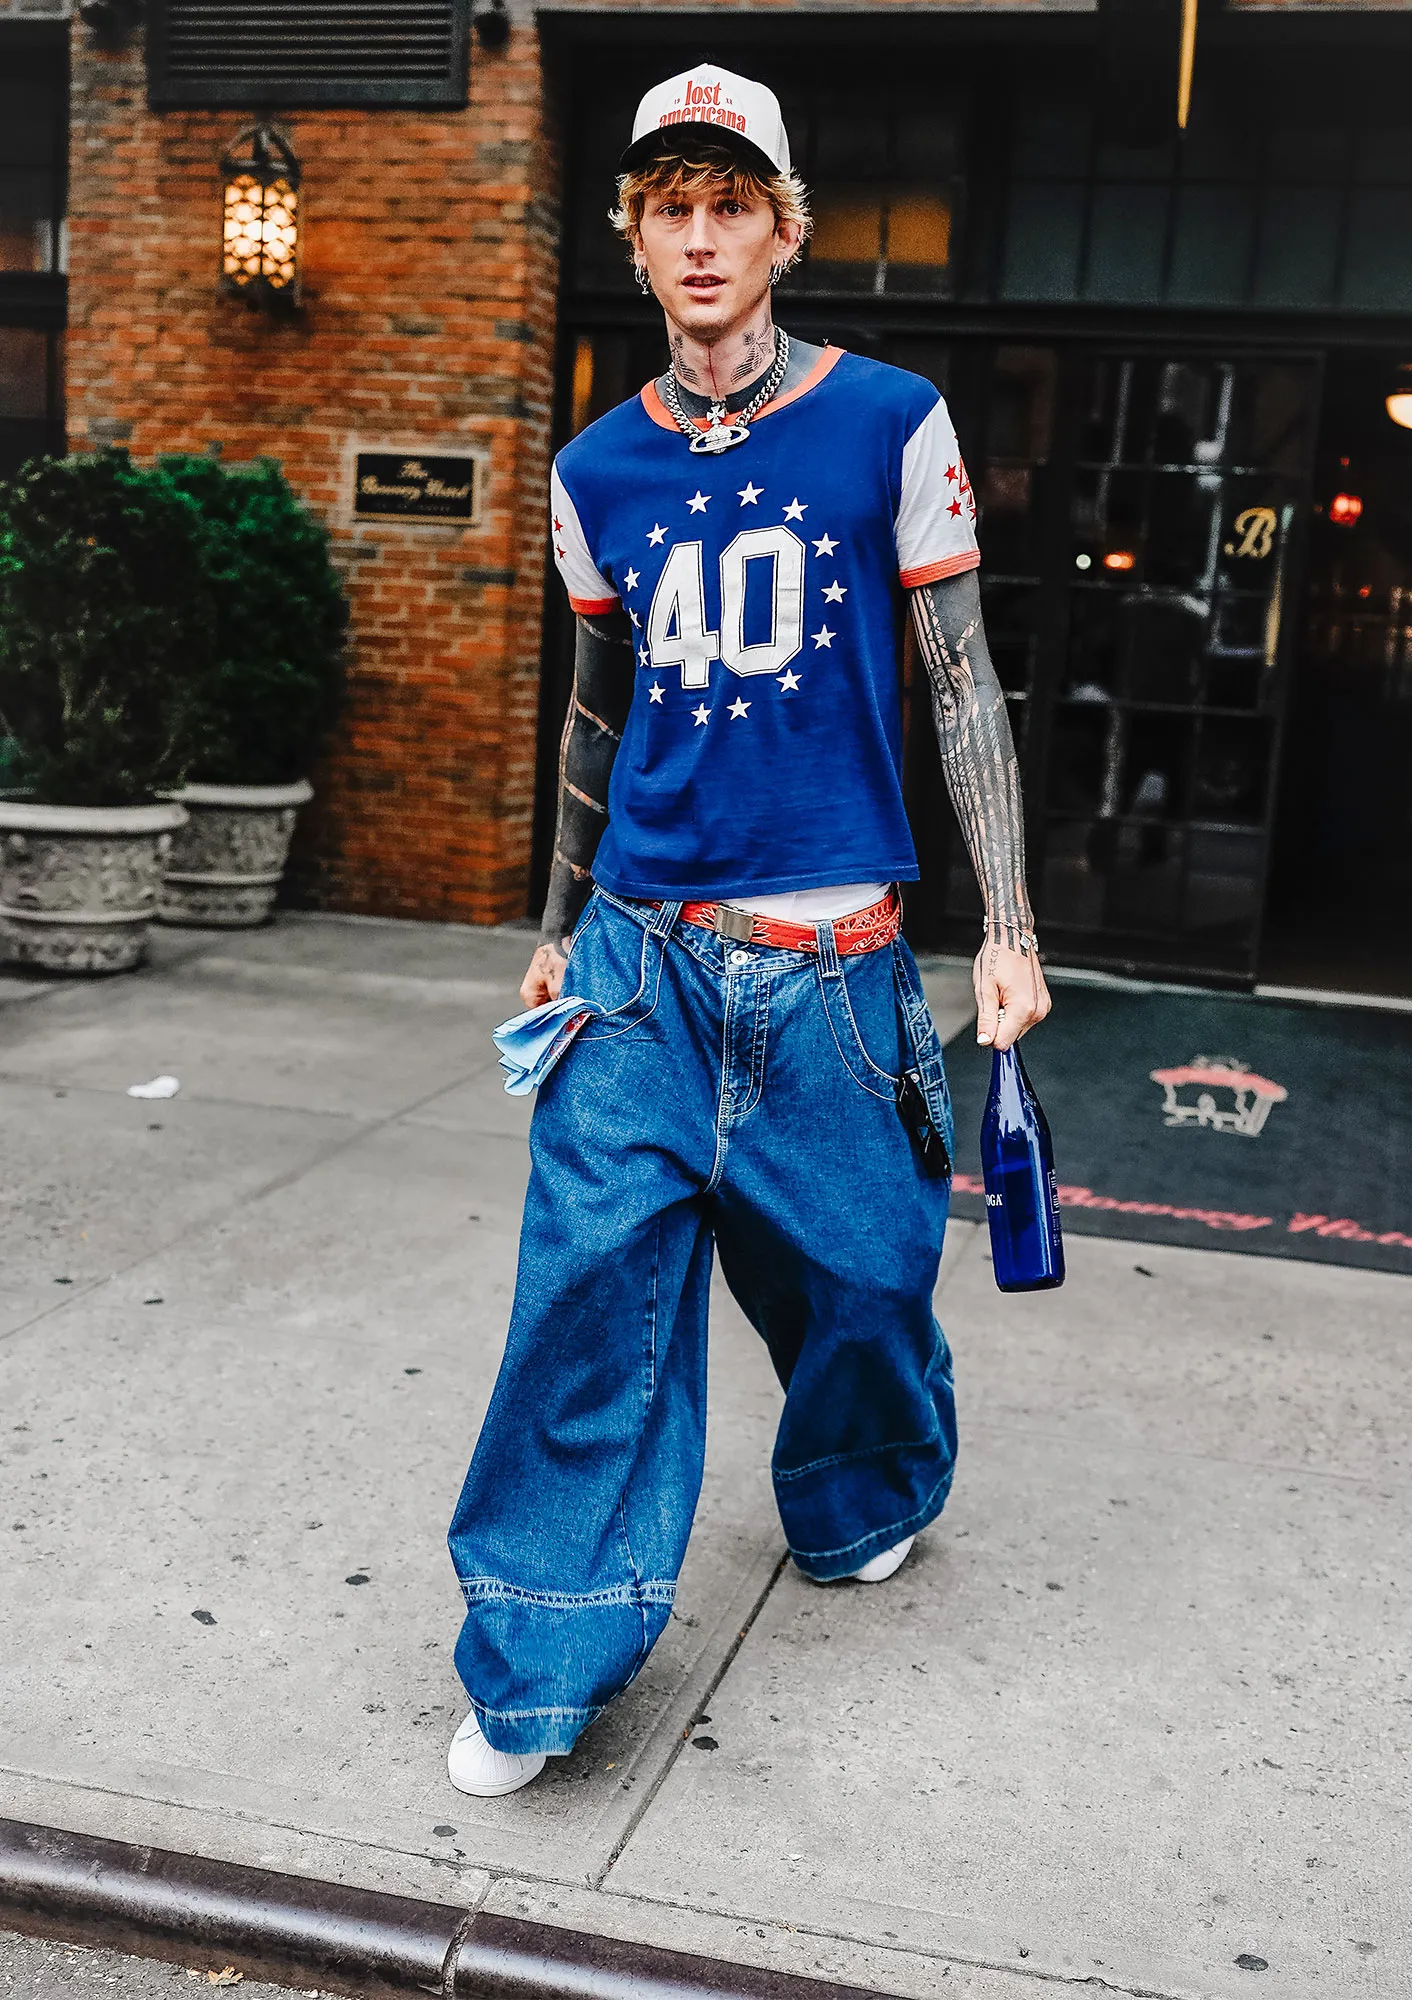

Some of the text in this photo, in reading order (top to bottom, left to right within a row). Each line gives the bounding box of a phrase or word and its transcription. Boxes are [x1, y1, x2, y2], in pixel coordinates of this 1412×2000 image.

[684, 80, 722, 106] lost
[659, 106, 747, 133] americana
[1224, 506, 1278, 559] B
[647, 525, 806, 690] 40
